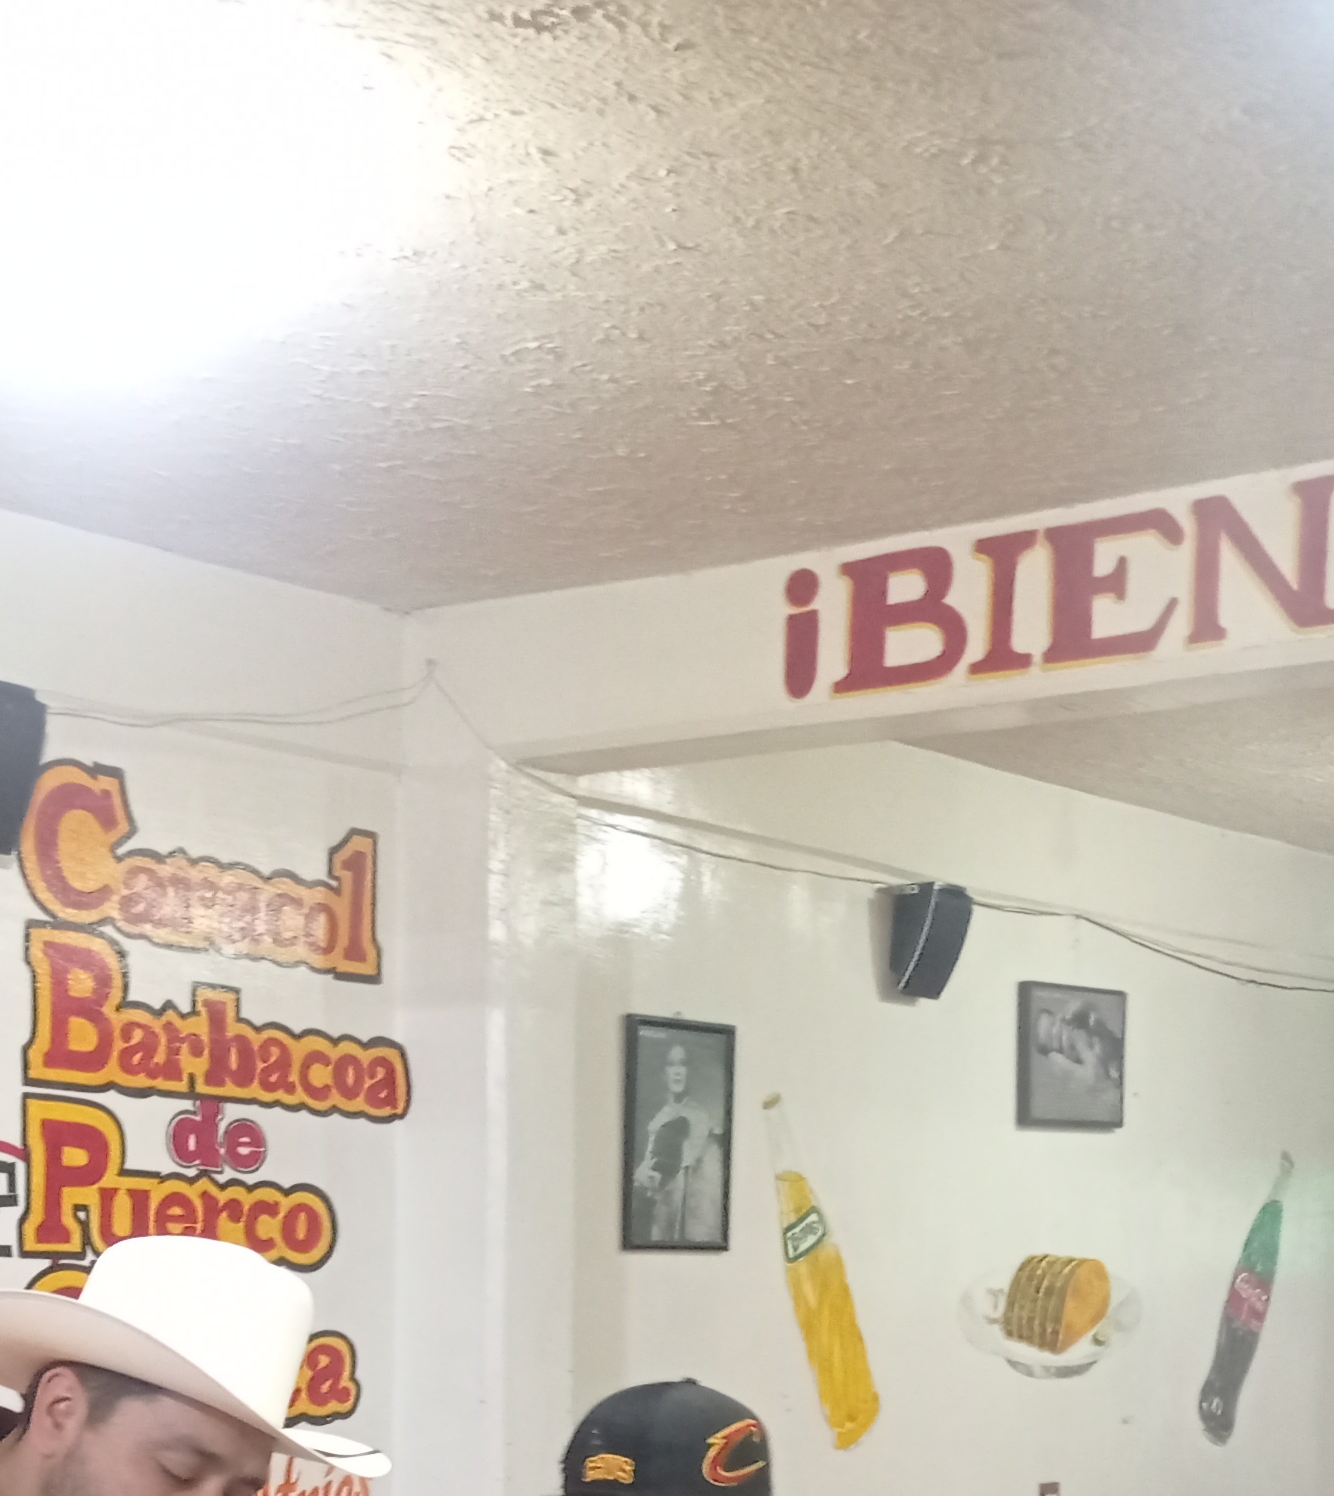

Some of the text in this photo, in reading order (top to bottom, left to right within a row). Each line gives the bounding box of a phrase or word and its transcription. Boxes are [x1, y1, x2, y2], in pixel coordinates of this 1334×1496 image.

[31, 925, 407, 1120] Barbacoa
[27, 1104, 331, 1264] Puerco
[170, 1098, 267, 1171] de
